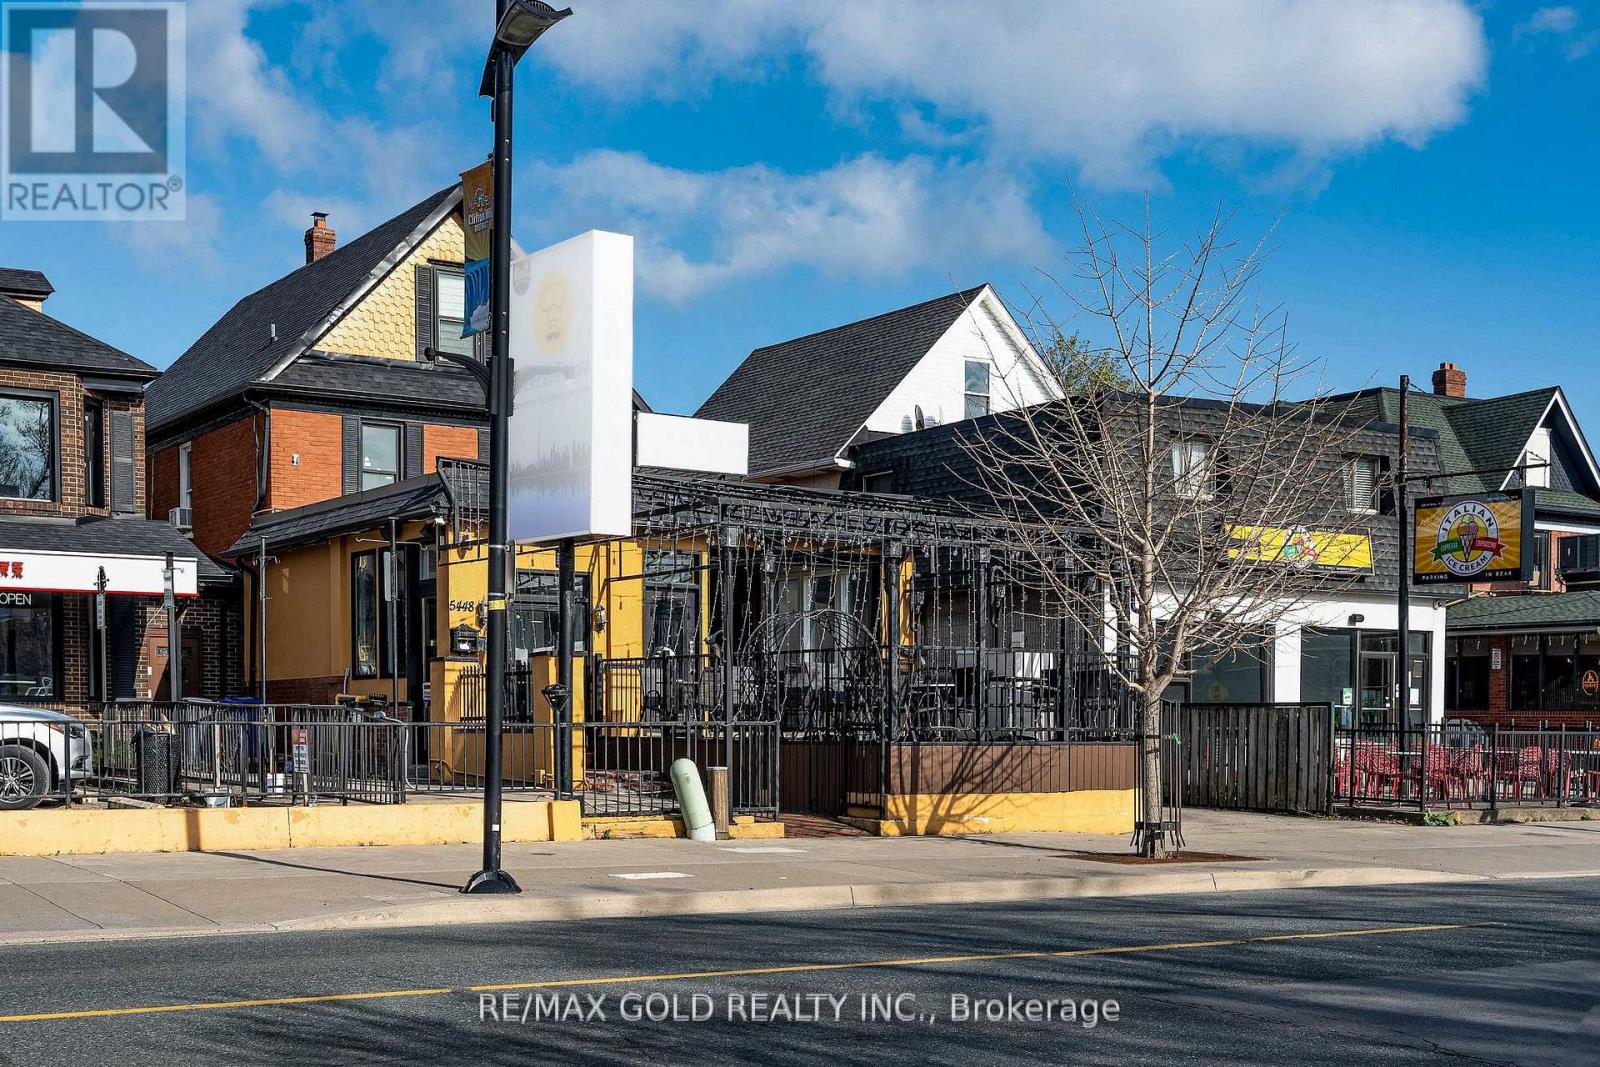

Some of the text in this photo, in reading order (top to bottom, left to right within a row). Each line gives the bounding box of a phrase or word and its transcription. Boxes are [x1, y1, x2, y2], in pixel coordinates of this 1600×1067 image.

[1441, 505, 1495, 532] ITALIAN
[1446, 555, 1488, 572] ICE CREAM
[1421, 573, 1448, 581] PARKING
[0, 592, 32, 605] OPEN
[449, 599, 475, 613] 5448
